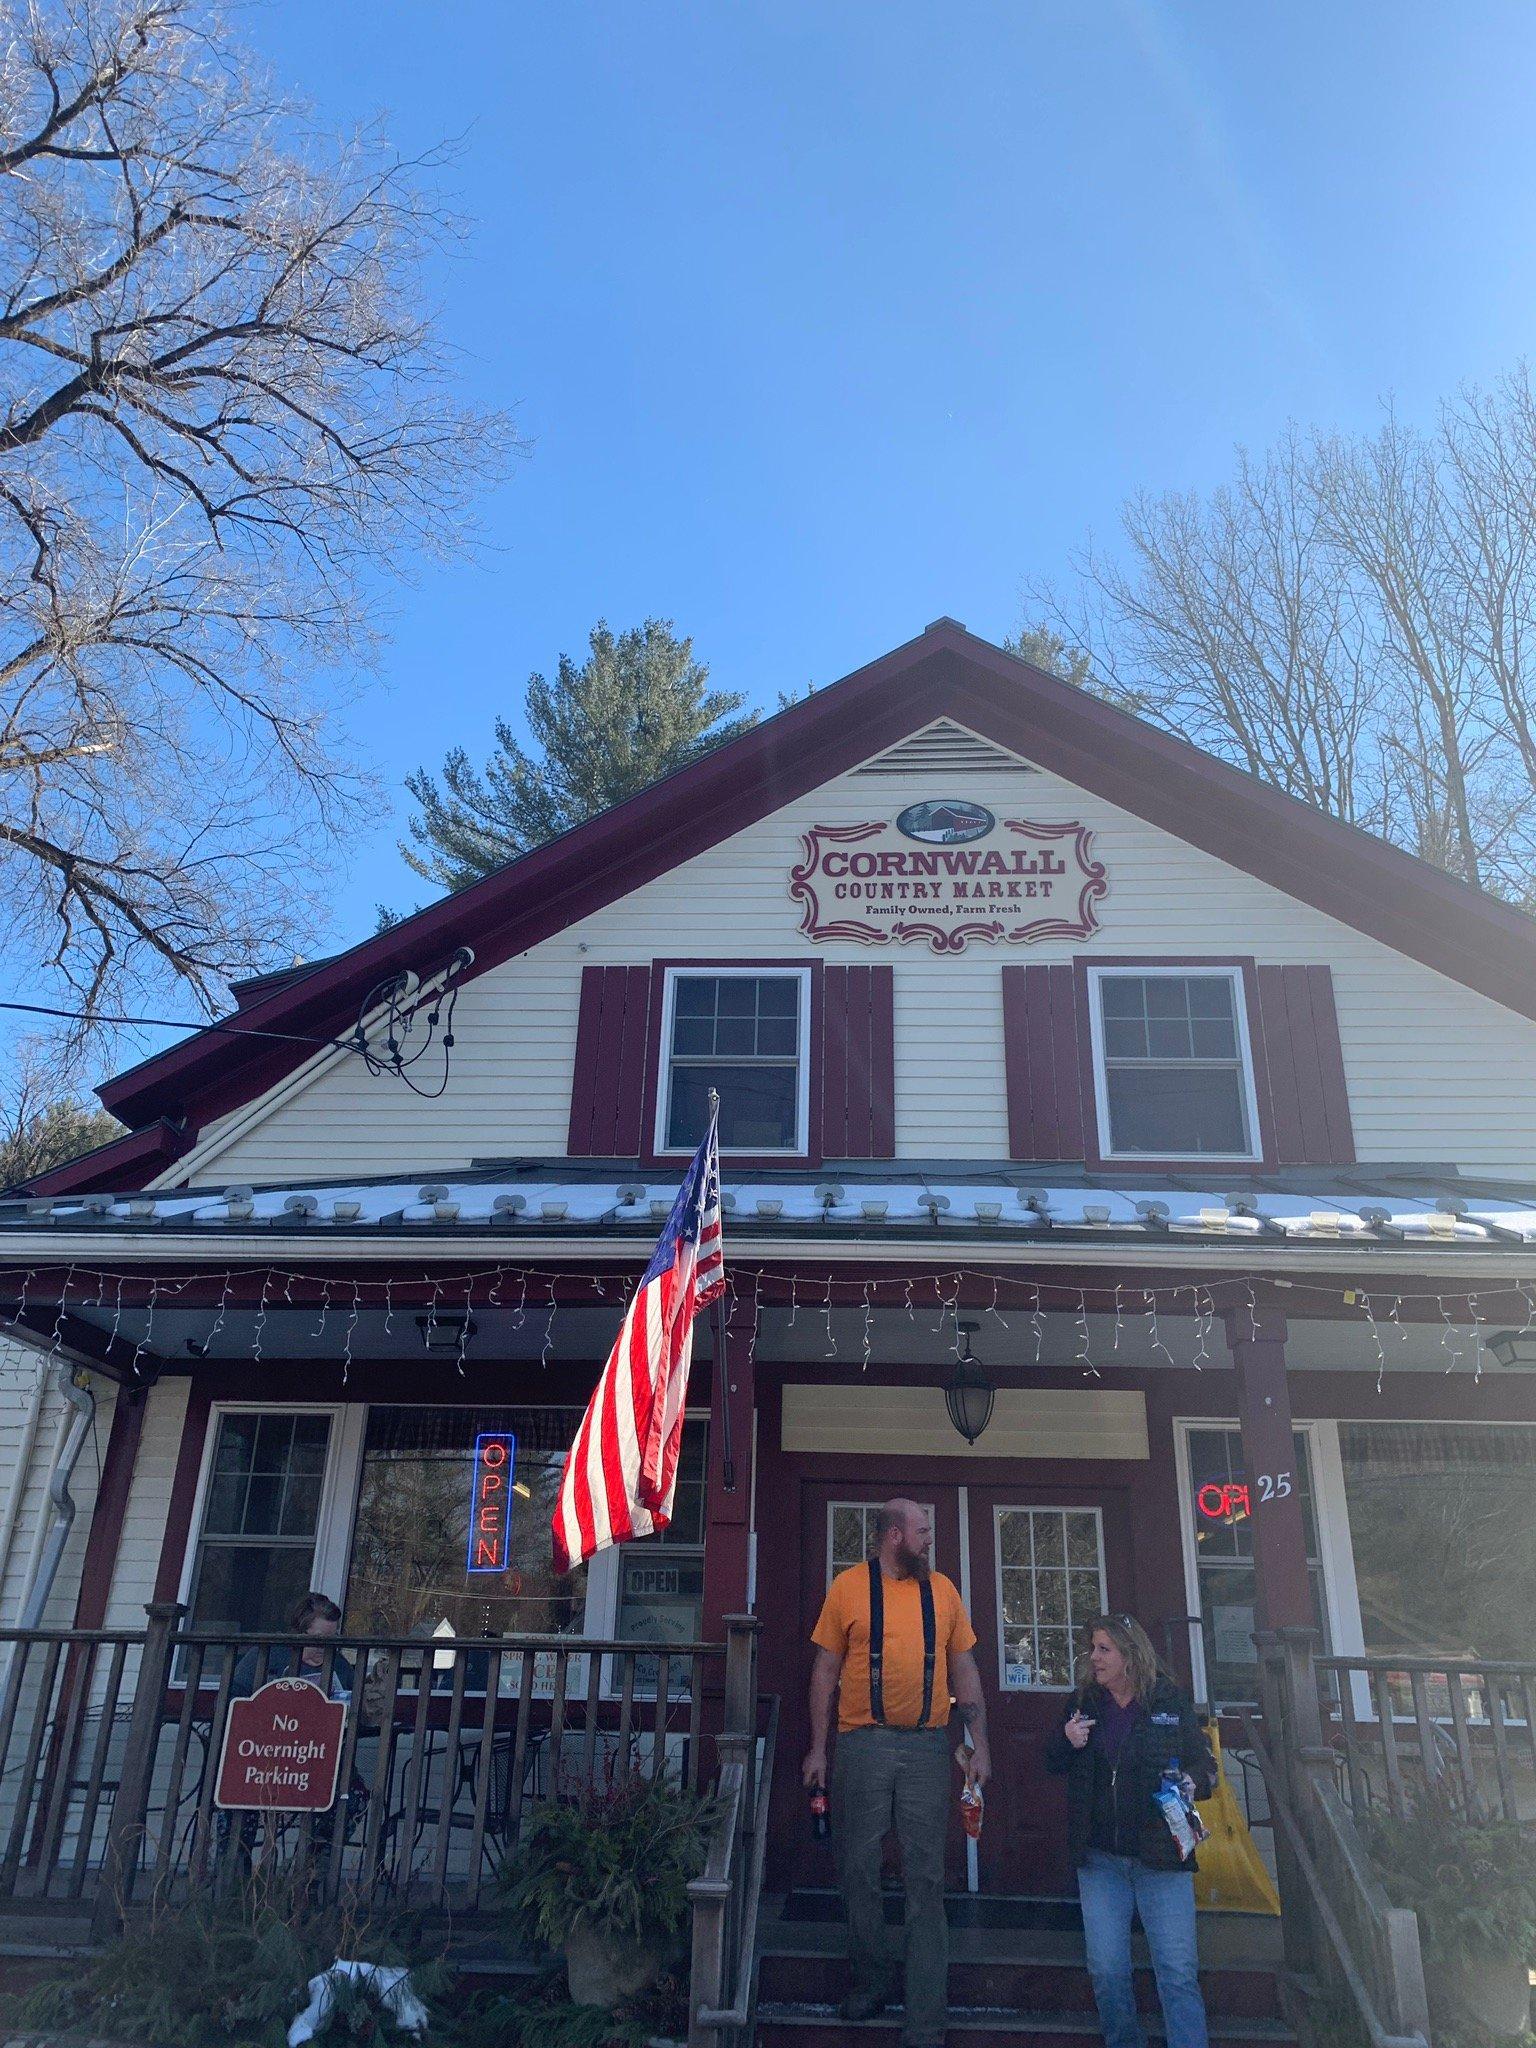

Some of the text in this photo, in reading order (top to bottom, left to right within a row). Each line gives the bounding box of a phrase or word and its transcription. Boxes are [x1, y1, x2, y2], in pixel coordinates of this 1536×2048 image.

[821, 850, 1066, 878] CORNWALL
[834, 881, 1053, 899] COUNTRY MARKET
[865, 903, 1022, 916] Family Owned, Farm Fresh
[1257, 1472, 1292, 1502] 25
[477, 1443, 506, 1565] OPEN
[631, 1570, 677, 1593] OPEN
[630, 1614, 686, 1633] Proudly Serving
[1007, 1674, 1030, 1684] WiFi
[272, 1713, 299, 1732] No
[238, 1739, 326, 1764] Overnight
[244, 1765, 310, 1791] Parking
